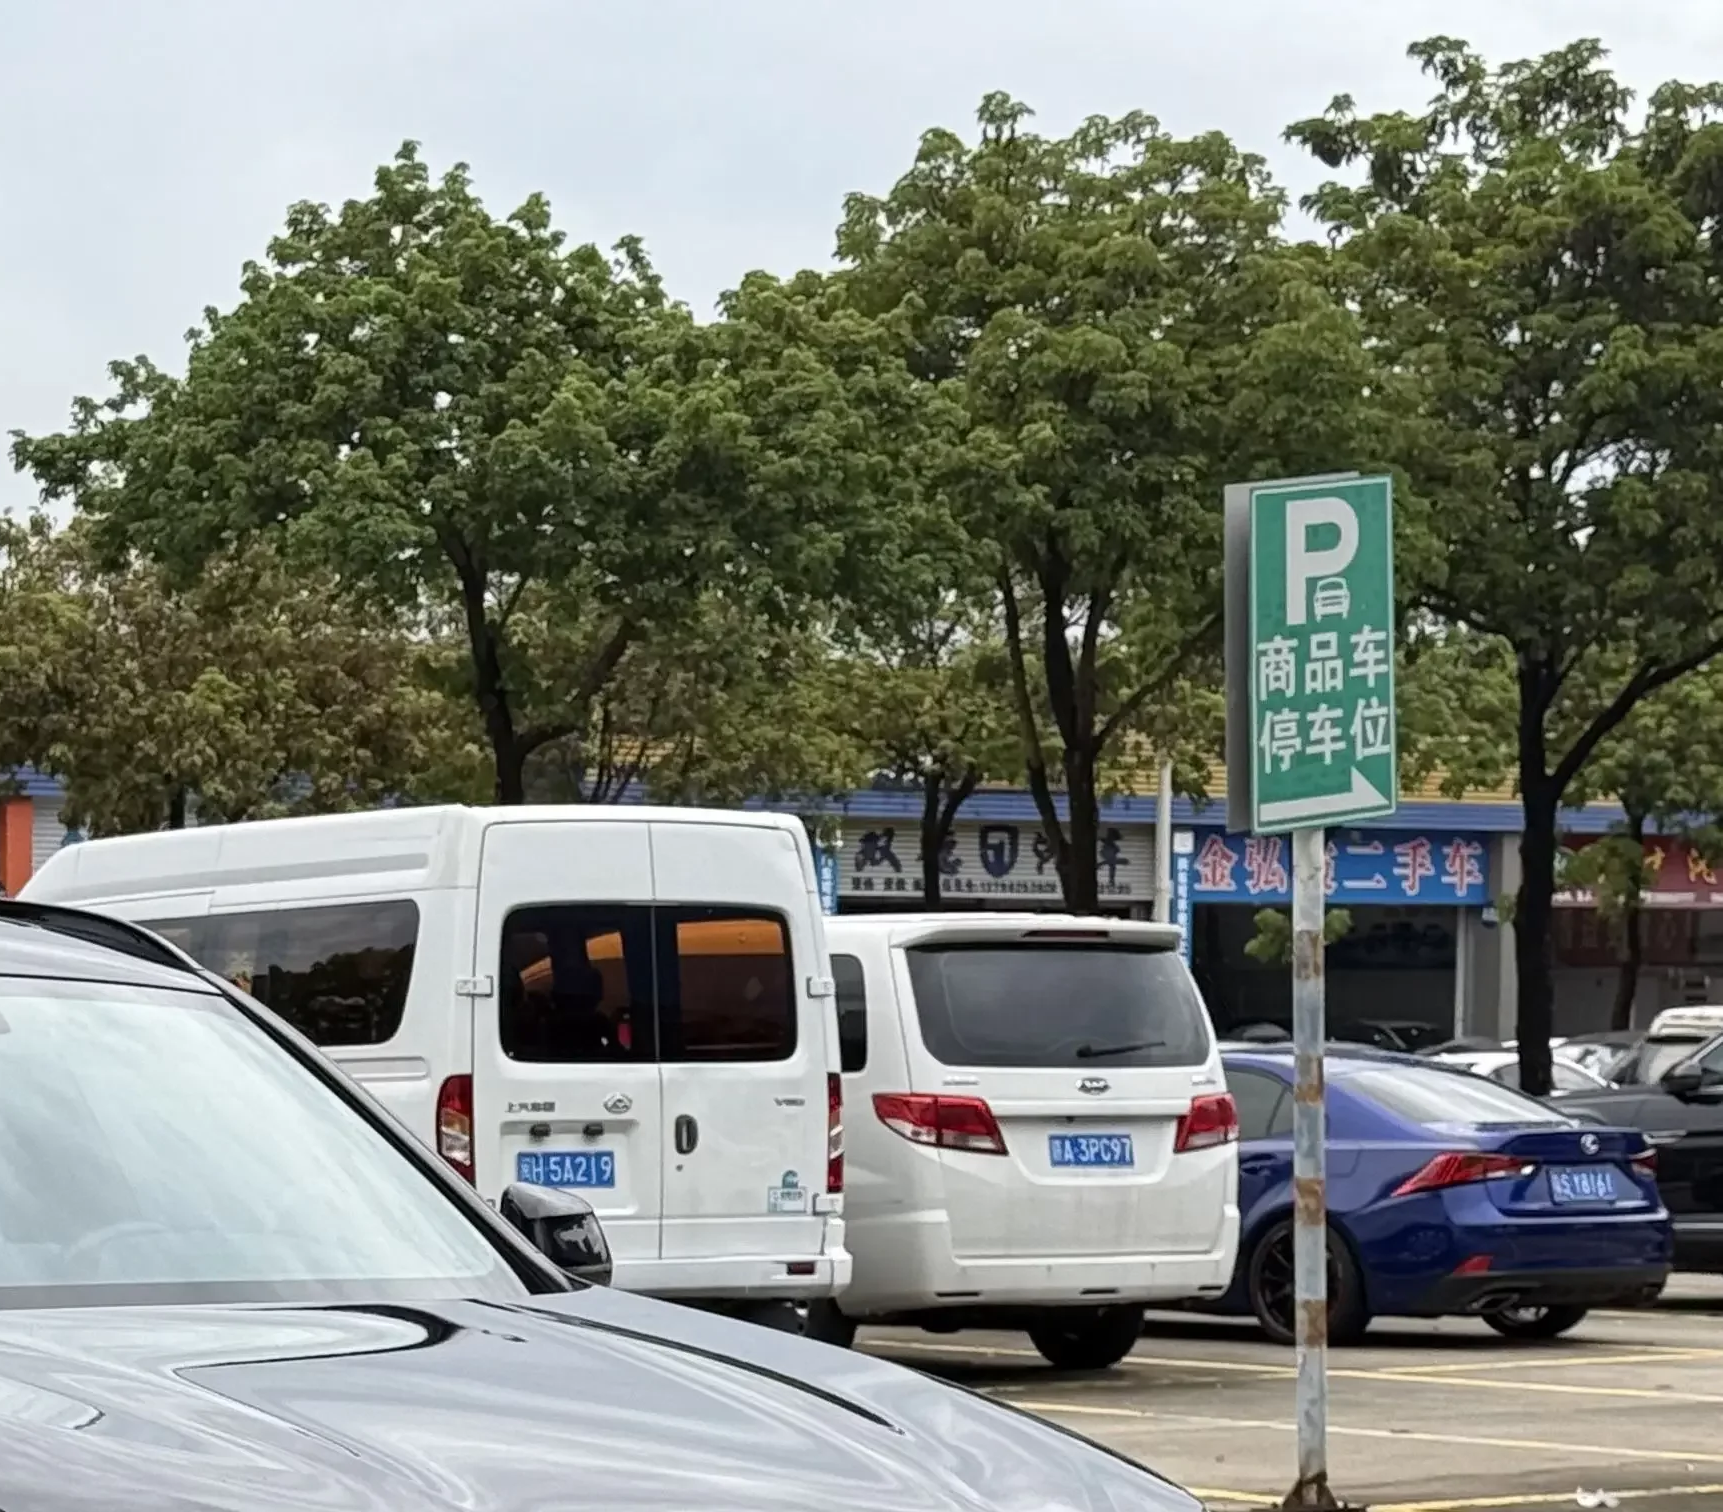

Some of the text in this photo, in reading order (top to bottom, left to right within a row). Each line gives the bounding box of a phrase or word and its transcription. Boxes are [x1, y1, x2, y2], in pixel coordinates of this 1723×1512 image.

[1286, 497, 1359, 625] P
[1257, 625, 1389, 701] 商品车
[1259, 696, 1391, 774] 停车位
[1193, 834, 1483, 896] 金弘二手车
